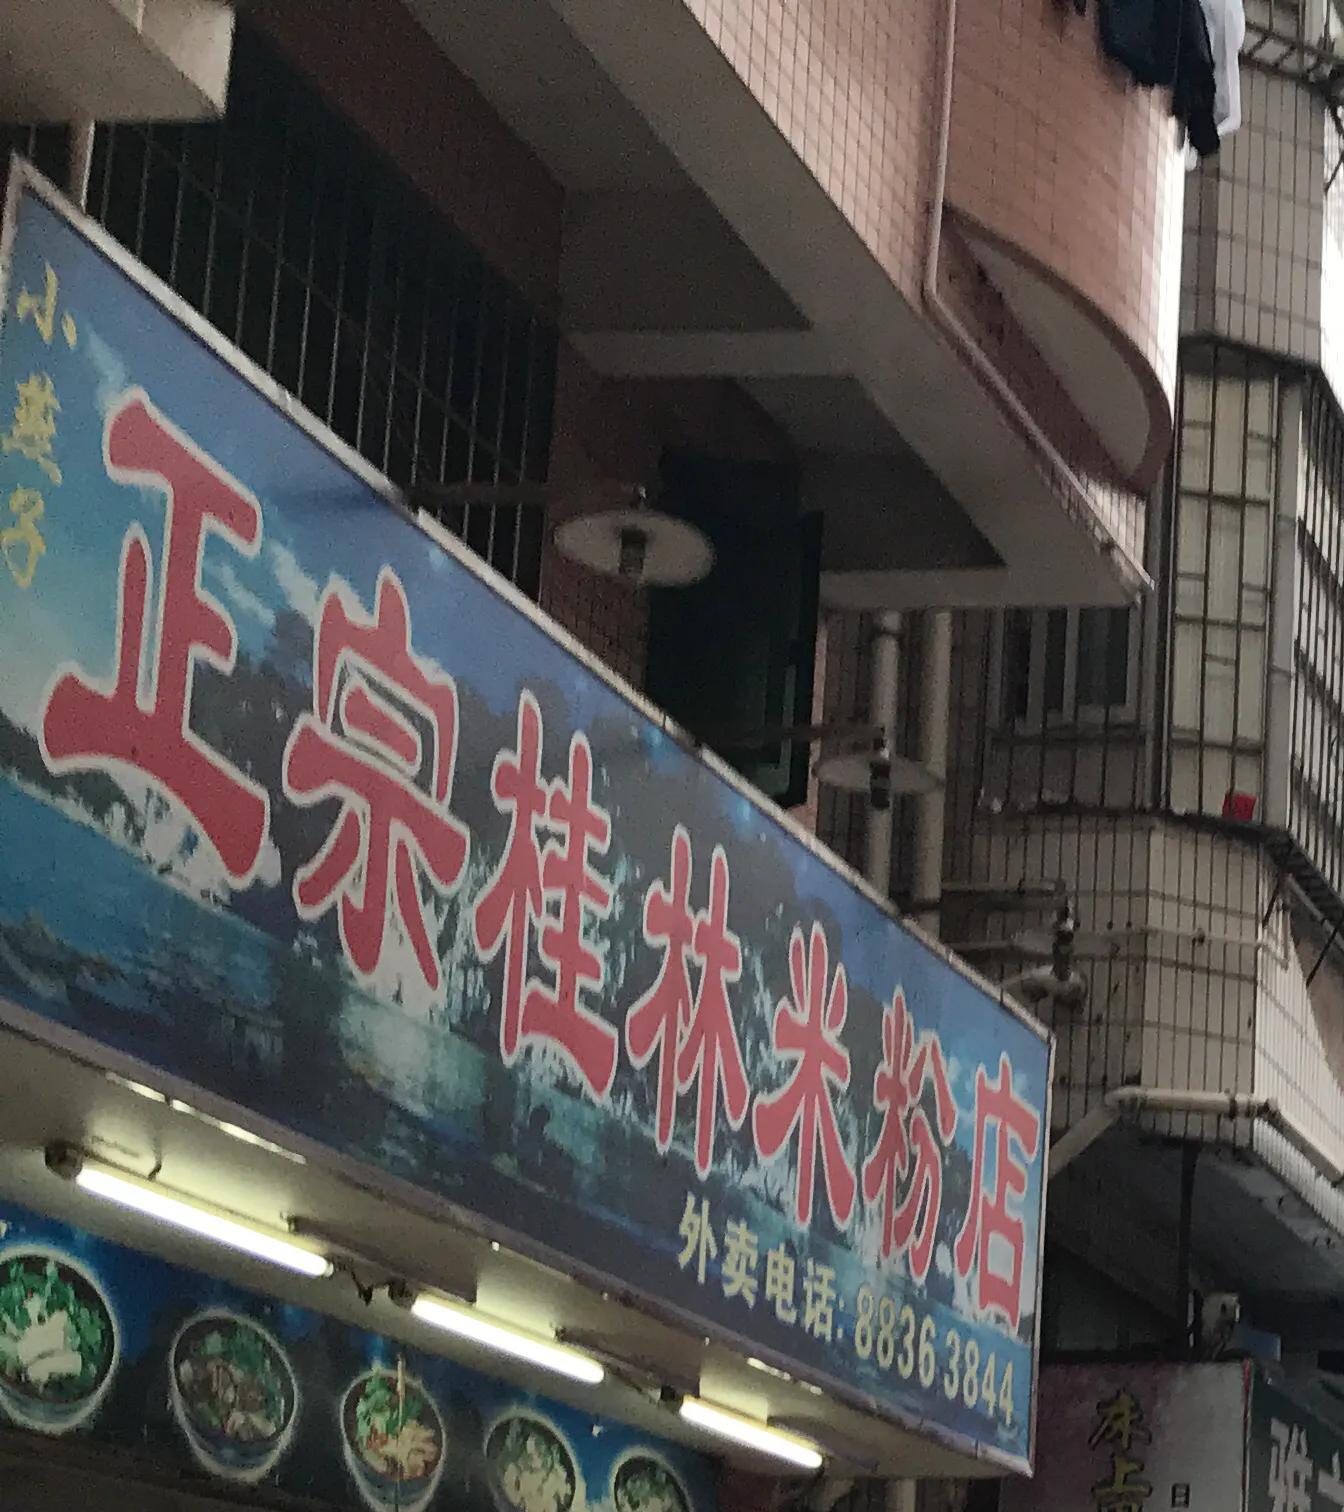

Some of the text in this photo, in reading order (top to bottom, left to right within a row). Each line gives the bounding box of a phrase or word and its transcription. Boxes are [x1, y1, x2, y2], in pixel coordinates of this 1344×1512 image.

[40, 390, 1038, 1335] 正宗桂林米粉店
